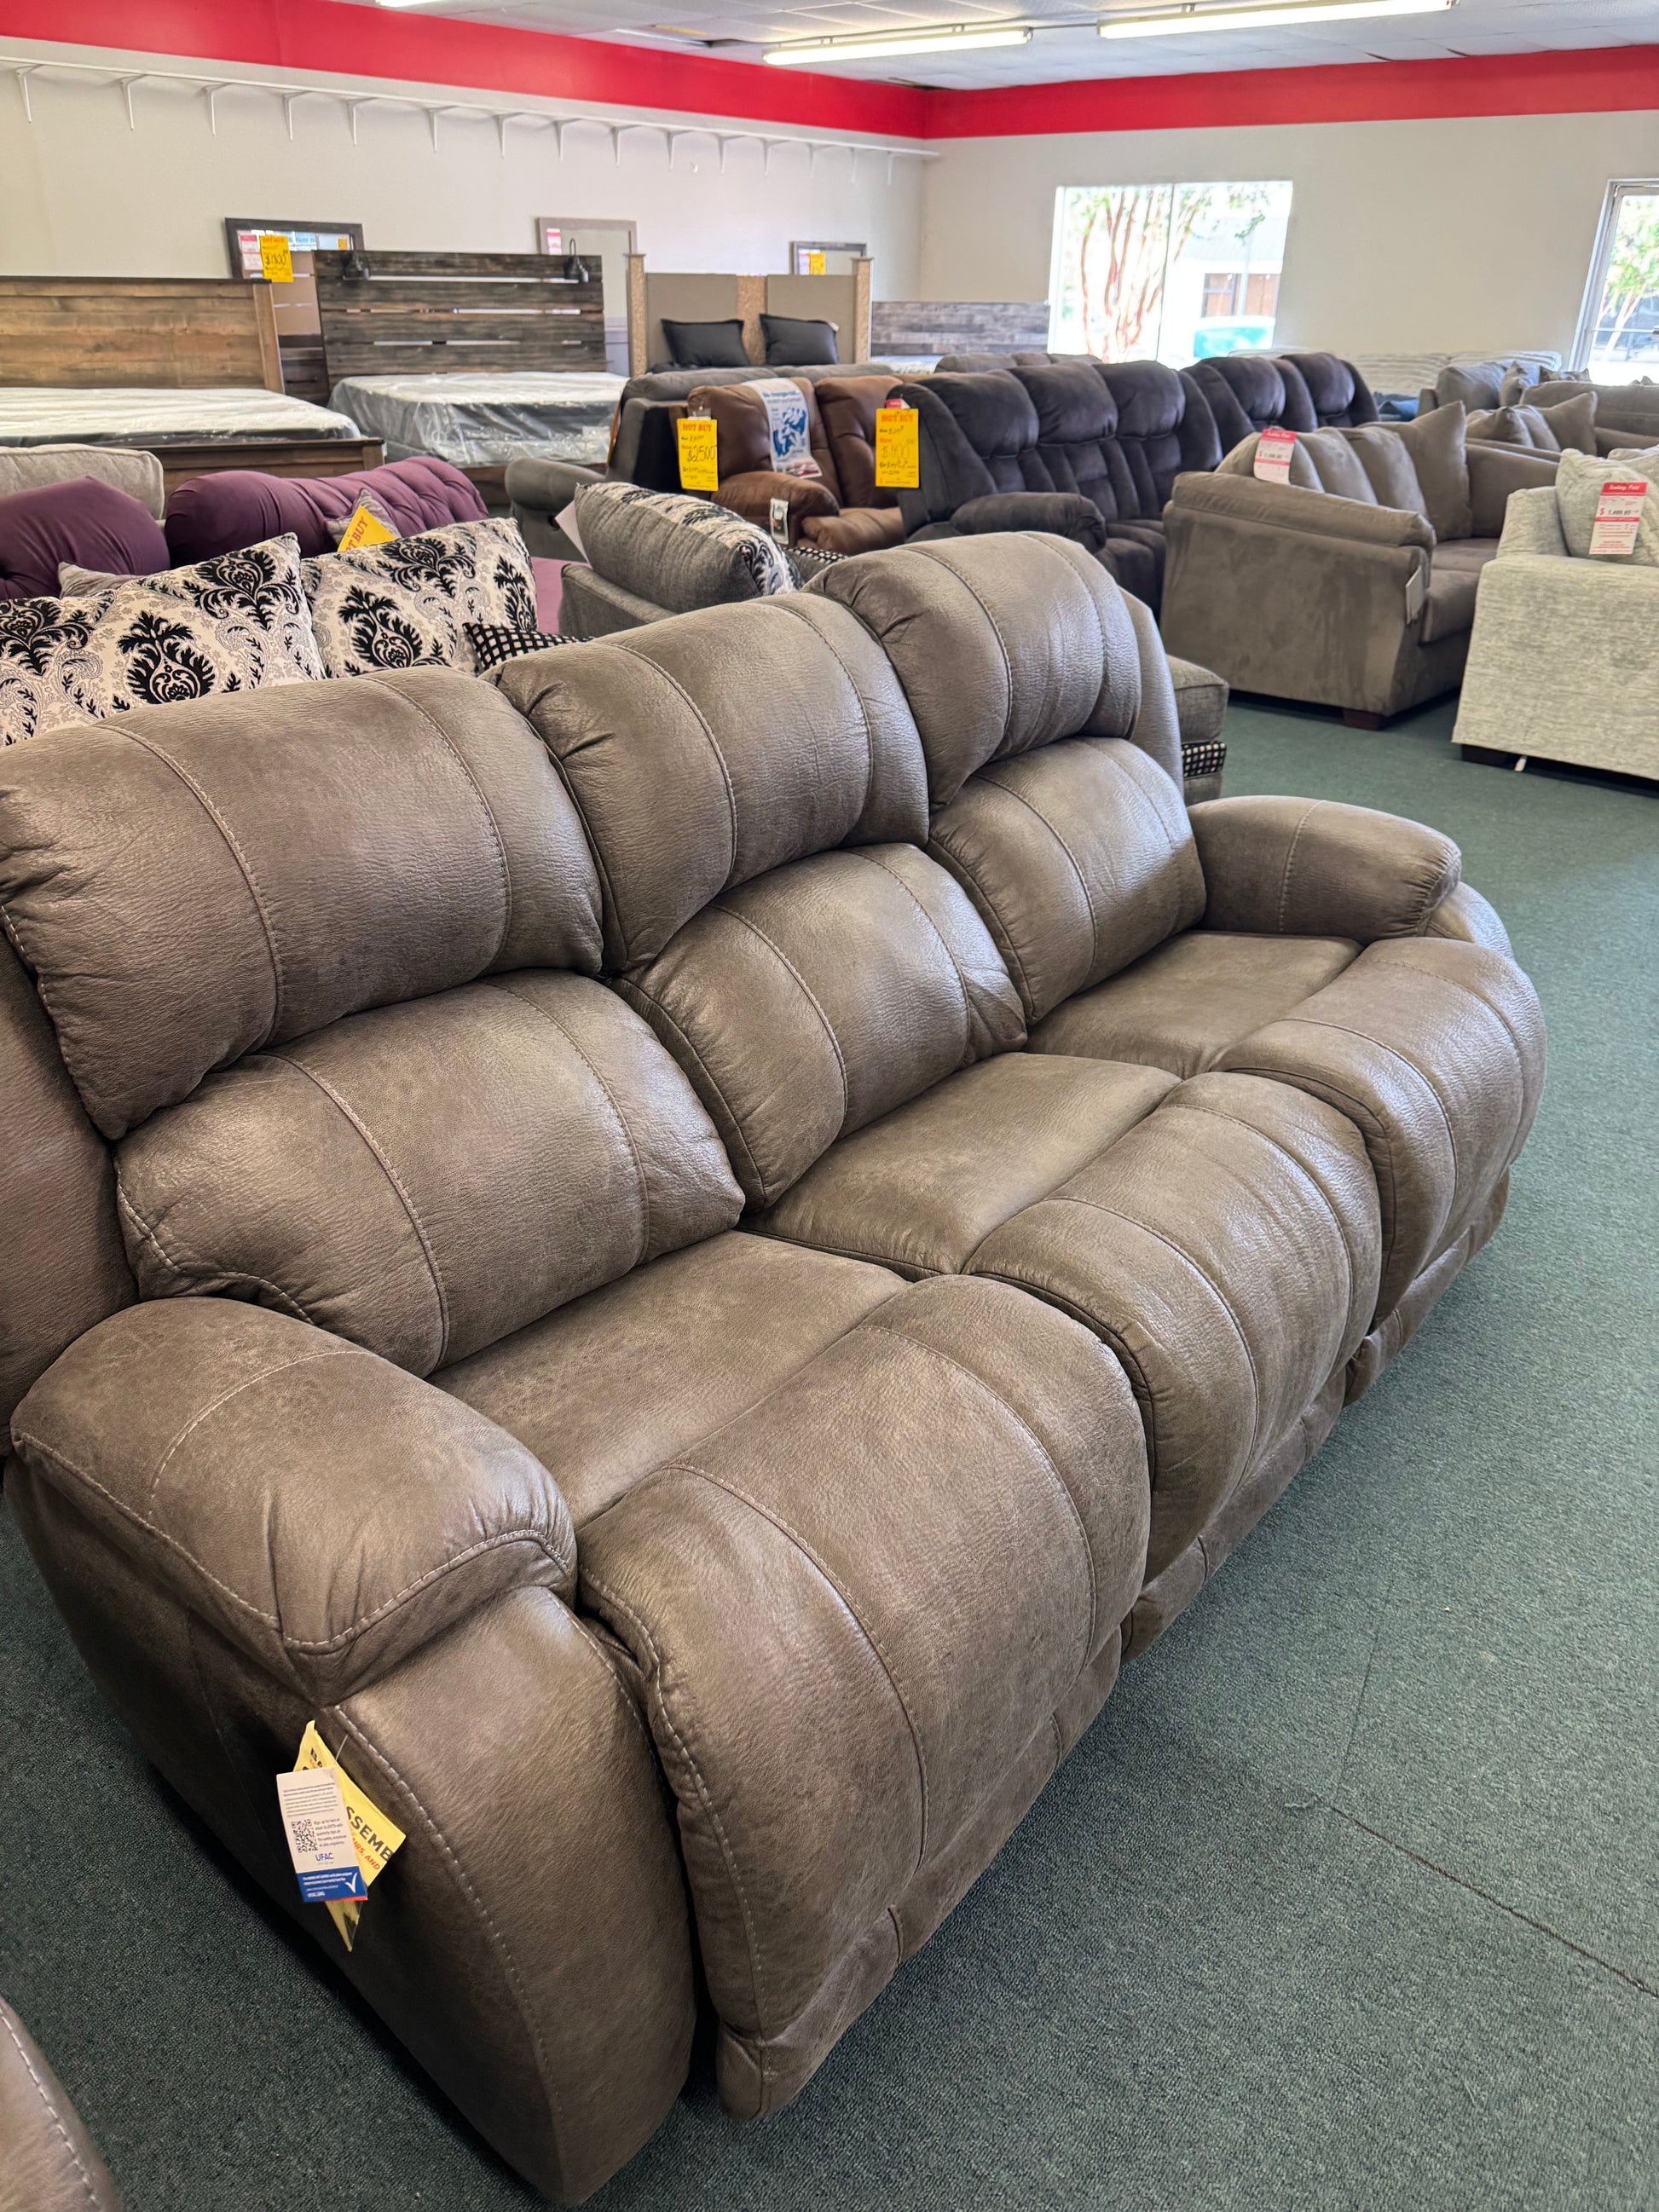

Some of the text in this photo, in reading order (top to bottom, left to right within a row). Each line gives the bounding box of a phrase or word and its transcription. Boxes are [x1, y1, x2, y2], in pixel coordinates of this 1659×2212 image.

[881, 413, 897, 423] HOT
[682, 423, 712, 431] HOT BUY
[351, 516, 368, 542] BUY
[315, 1852, 334, 1862] UFAC
[365, 1855, 381, 1870] AND
